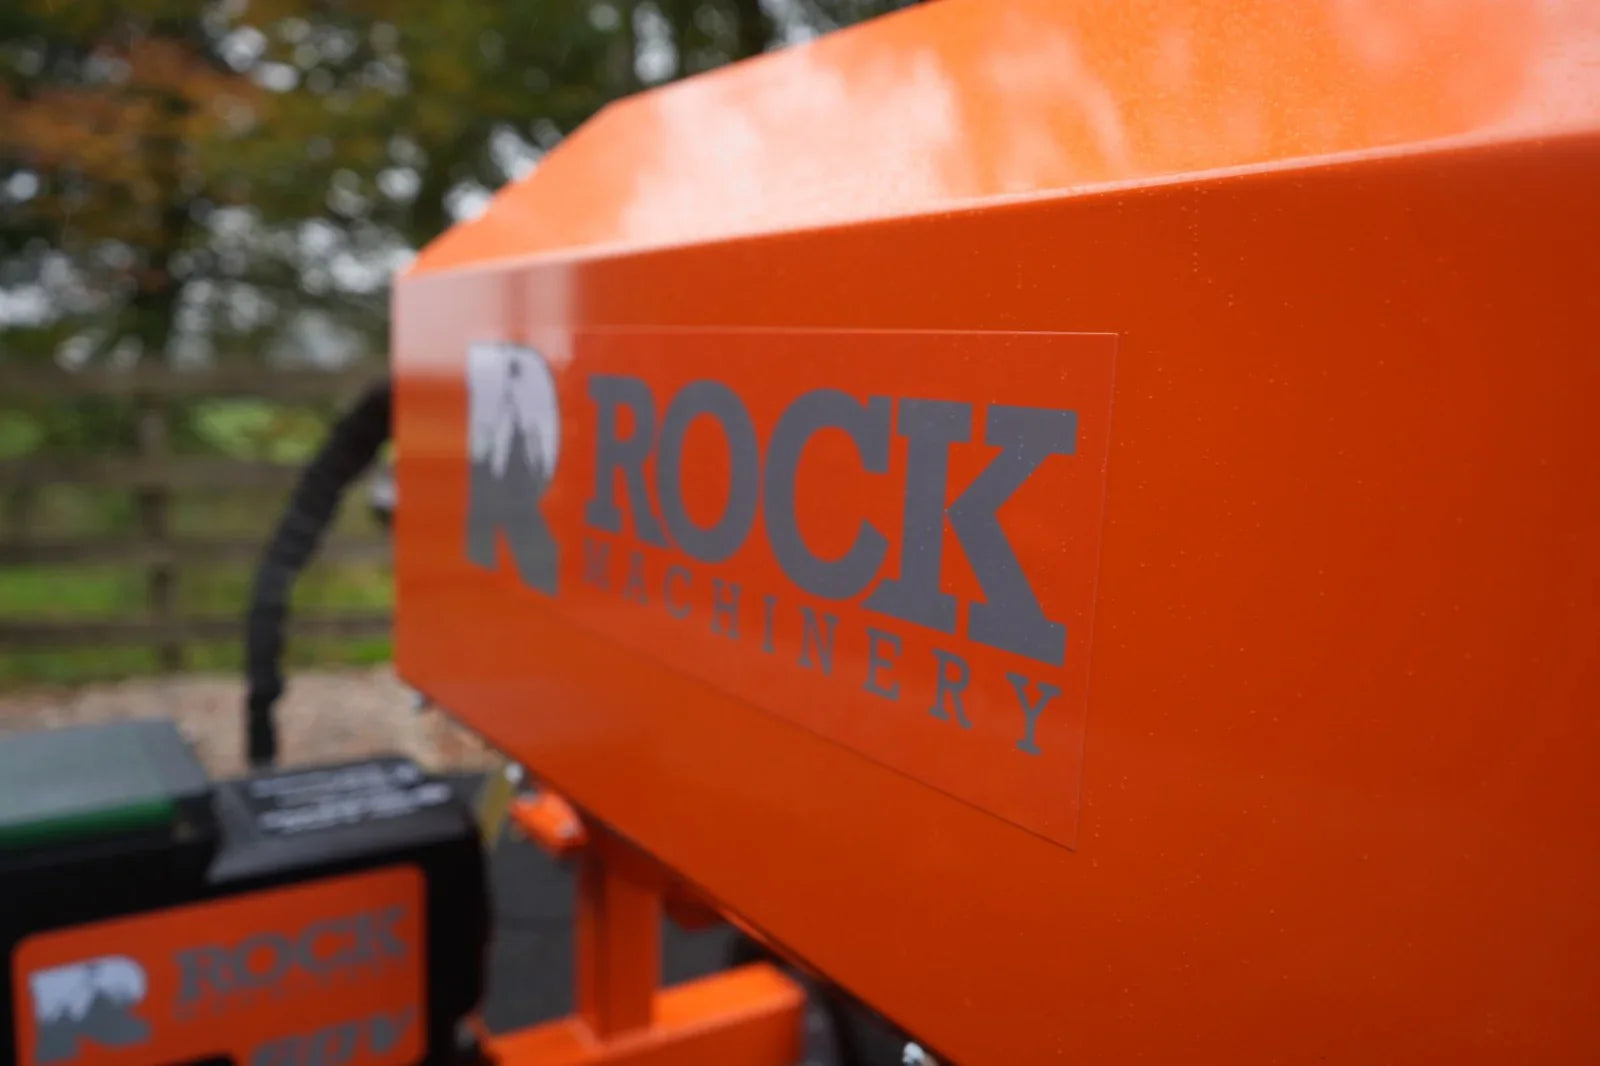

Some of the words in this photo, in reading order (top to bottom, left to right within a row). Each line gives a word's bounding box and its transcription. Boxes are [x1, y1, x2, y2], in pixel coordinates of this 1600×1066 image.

[584, 373, 1078, 667] ROCK
[582, 537, 1062, 755] MACHINERY
[173, 905, 408, 1003] ROCK
